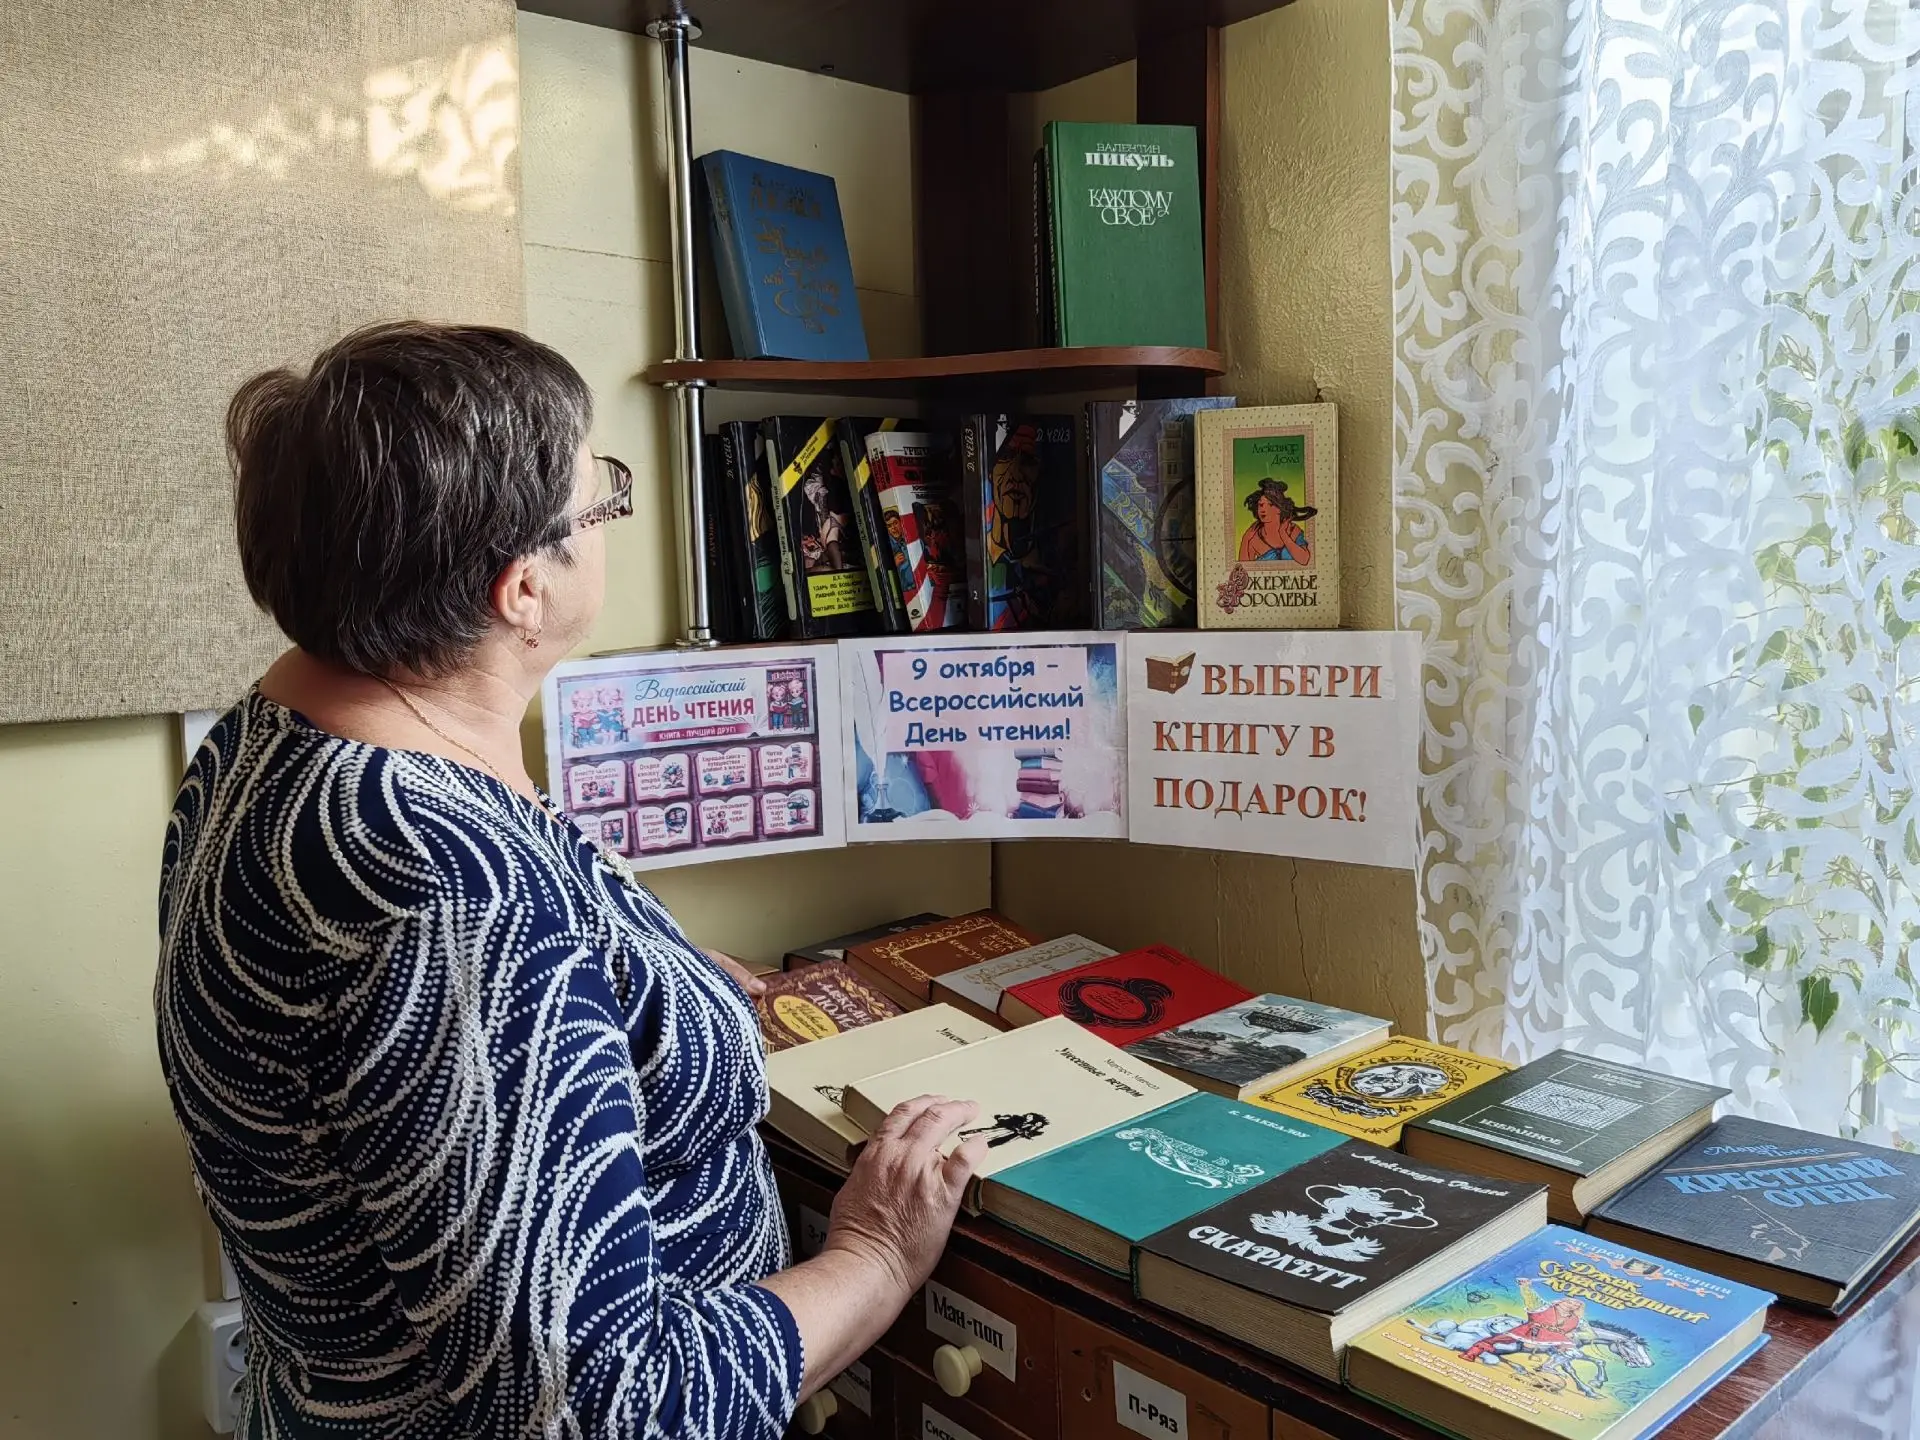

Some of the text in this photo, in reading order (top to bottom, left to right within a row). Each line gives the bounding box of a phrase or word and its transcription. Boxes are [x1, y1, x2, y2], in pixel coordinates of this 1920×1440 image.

[1084, 152, 1175, 171] ПИКУЛЬ
[1096, 143, 1160, 153] ВАЛЕНТИН
[1088, 188, 1173, 217] КАЖДОМУ
[1101, 207, 1156, 226] СВОЕ
[911, 658, 928, 681] 9
[939, 659, 1035, 684] октября
[1201, 663, 1383, 699] ВЫБЕРИ
[635, 678, 746, 703] Всероссийский
[889, 686, 1084, 717] Всероссийский
[632, 697, 755, 728] ДЕНЬ ЧТЕНИЯ
[659, 731, 680, 740] КНИГА
[686, 728, 715, 739] ЛУЧШИЙ
[904, 718, 1071, 747] День чтения!
[1152, 720, 1336, 758] КНИГУ В
[1152, 777, 1368, 823] ПОДАРОК!
[1105, 1077, 1144, 1098] ветром
[1479, 1118, 1563, 1146] ИЗБРАННОЕ
[1703, 1144, 1778, 1156] Марио
[1351, 1153, 1445, 1184] Александра
[1664, 1157, 1905, 1194] КРЕСТНЫЙ
[1763, 1181, 1897, 1208] ОТЕЦ
[1188, 1224, 1367, 1289] СКАРЛЕТТ
[1567, 1238, 1733, 1296] Андрей Белянин
[1538, 1260, 1711, 1325] Сумасшедший
[1568, 1261, 1643, 1293] Джек
[931, 1291, 1004, 1351] Ман-поп
[1128, 1393, 1178, 1433] П-Ряз
